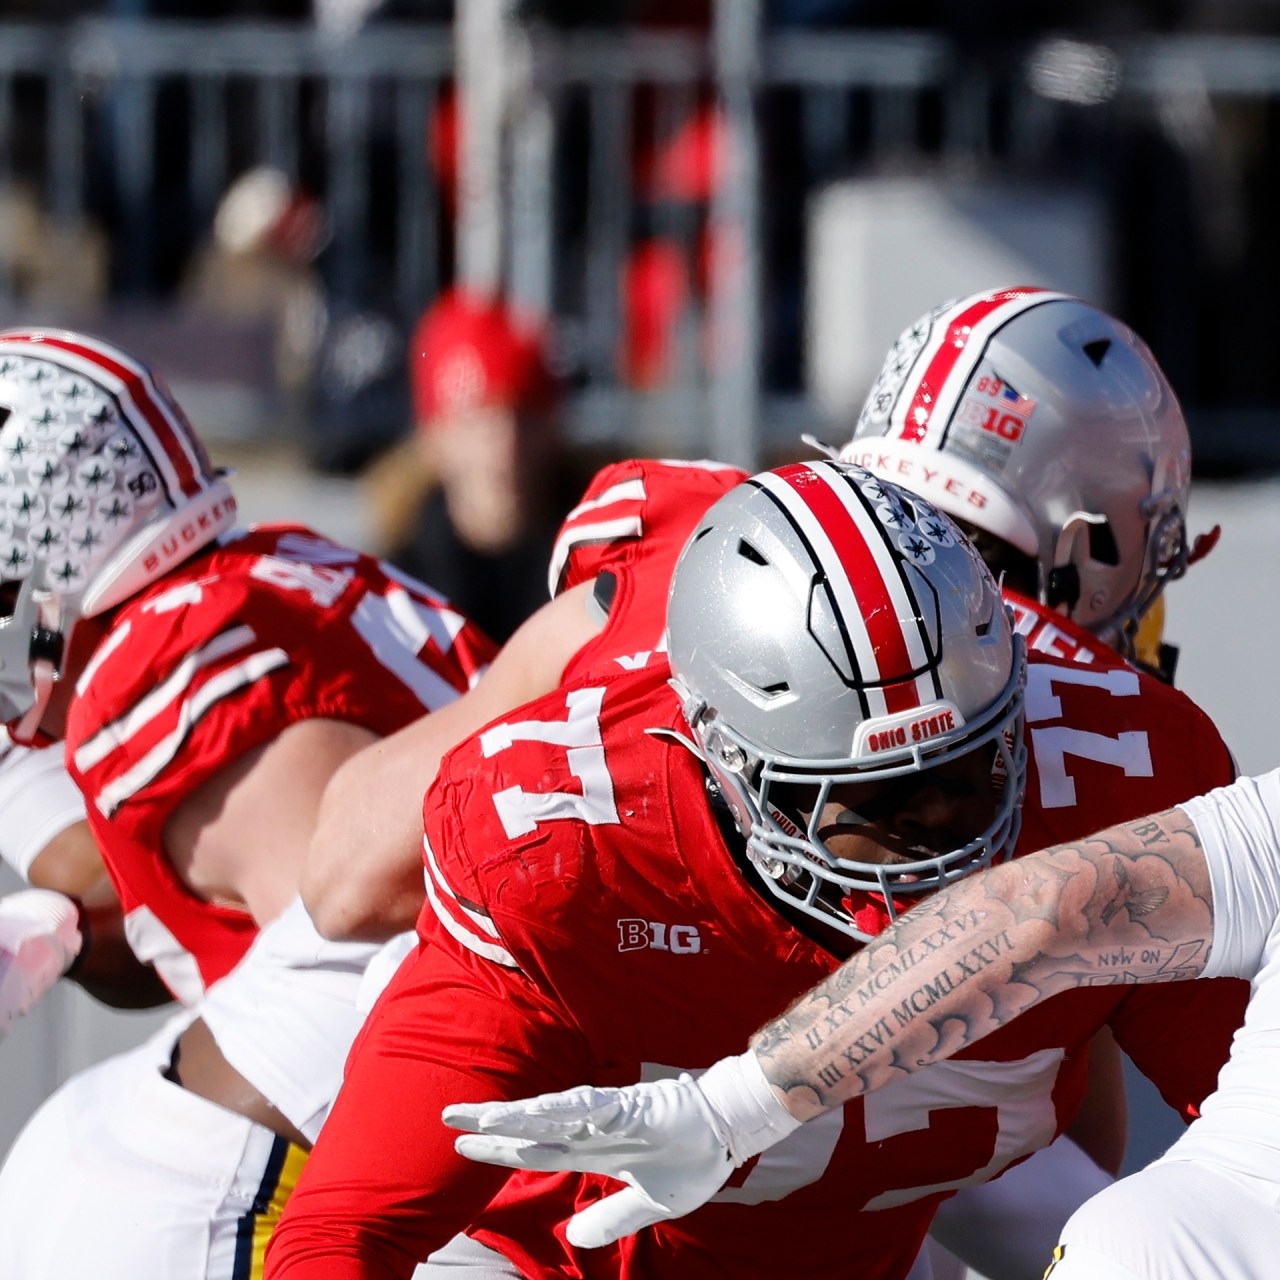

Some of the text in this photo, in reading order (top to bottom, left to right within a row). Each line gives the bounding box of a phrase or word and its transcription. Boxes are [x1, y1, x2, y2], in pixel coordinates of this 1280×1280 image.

[838, 451, 988, 509] UCKEYES
[868, 710, 955, 752] OHIO STATE
[480, 686, 621, 840] 77
[1141, 949, 1160, 964] NO
[817, 930, 1015, 1088] III XXVI MCMLXXVI
